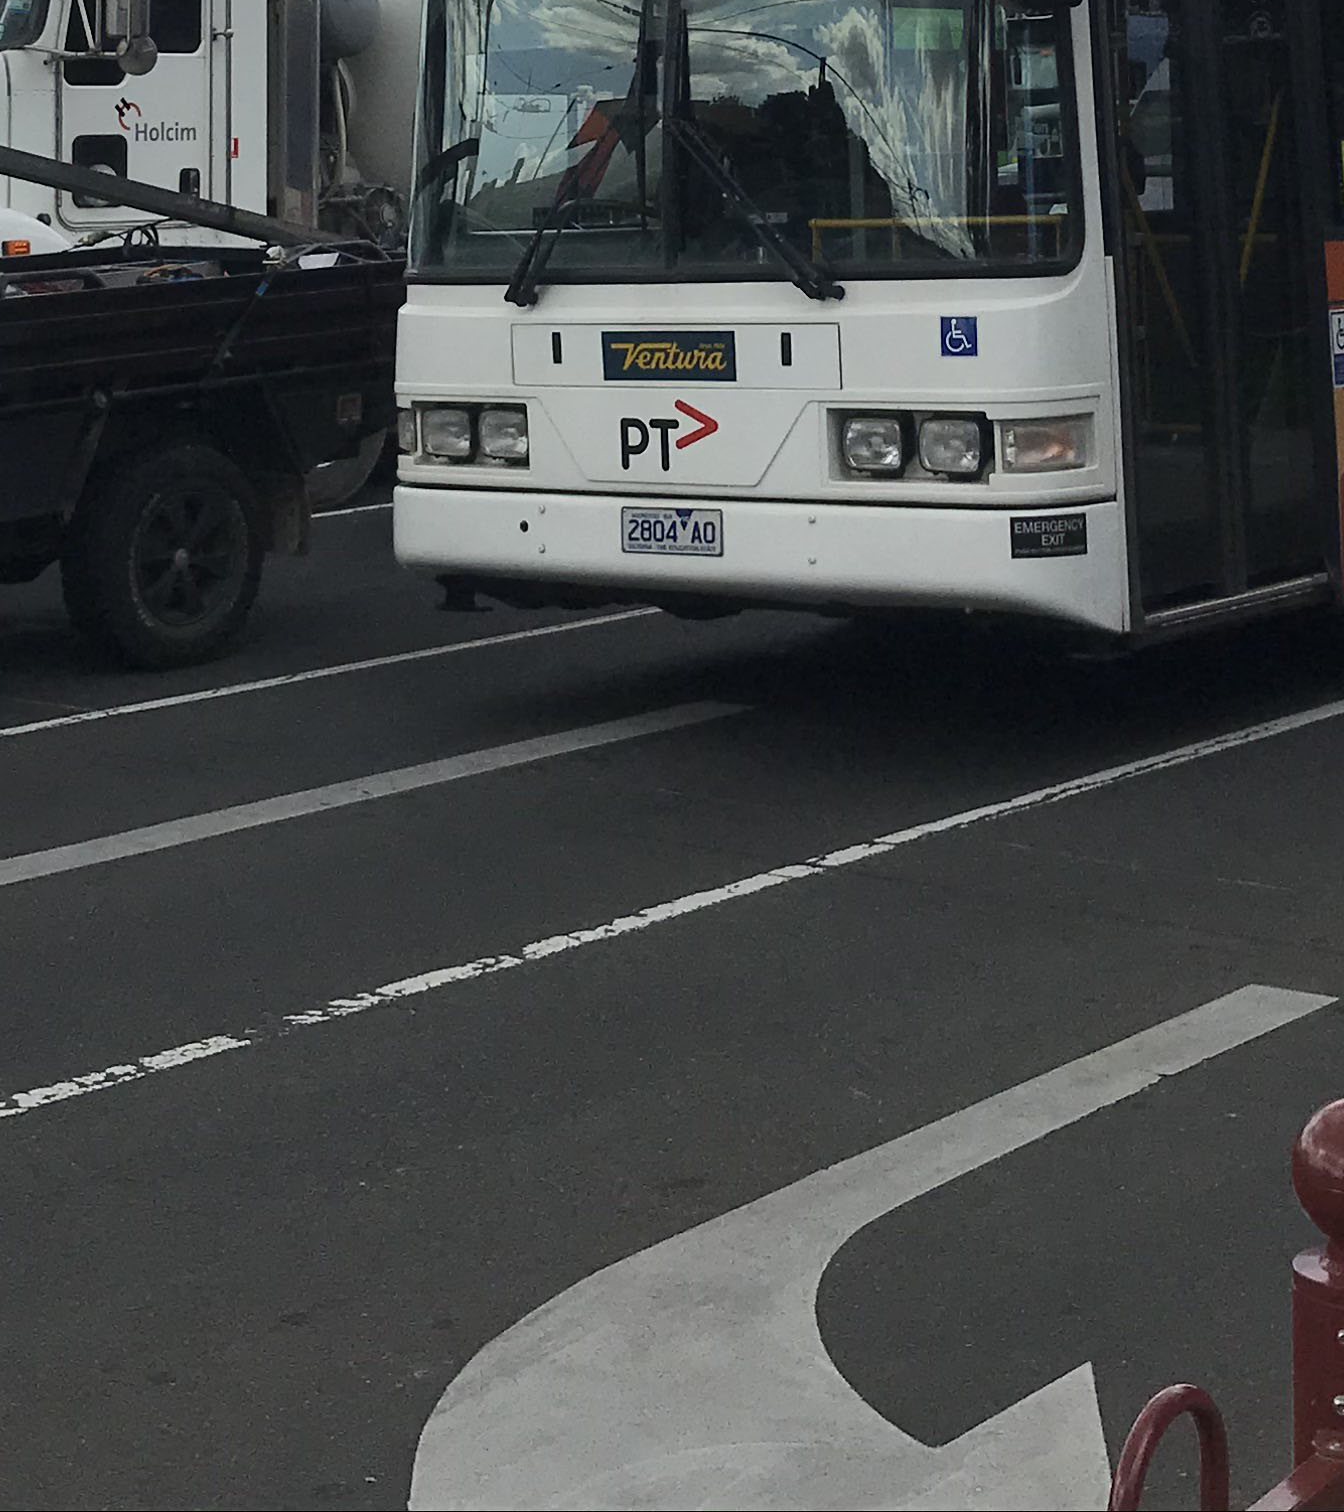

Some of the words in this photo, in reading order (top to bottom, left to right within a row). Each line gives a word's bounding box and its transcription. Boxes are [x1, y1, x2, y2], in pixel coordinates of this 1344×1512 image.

[134, 122, 197, 142] Holcim
[610, 340, 727, 371] Ventura
[620, 417, 680, 472] PT
[628, 520, 678, 543] 2804
[1014, 518, 1084, 534] EMERGENCY
[1041, 533, 1066, 547] EXIT
